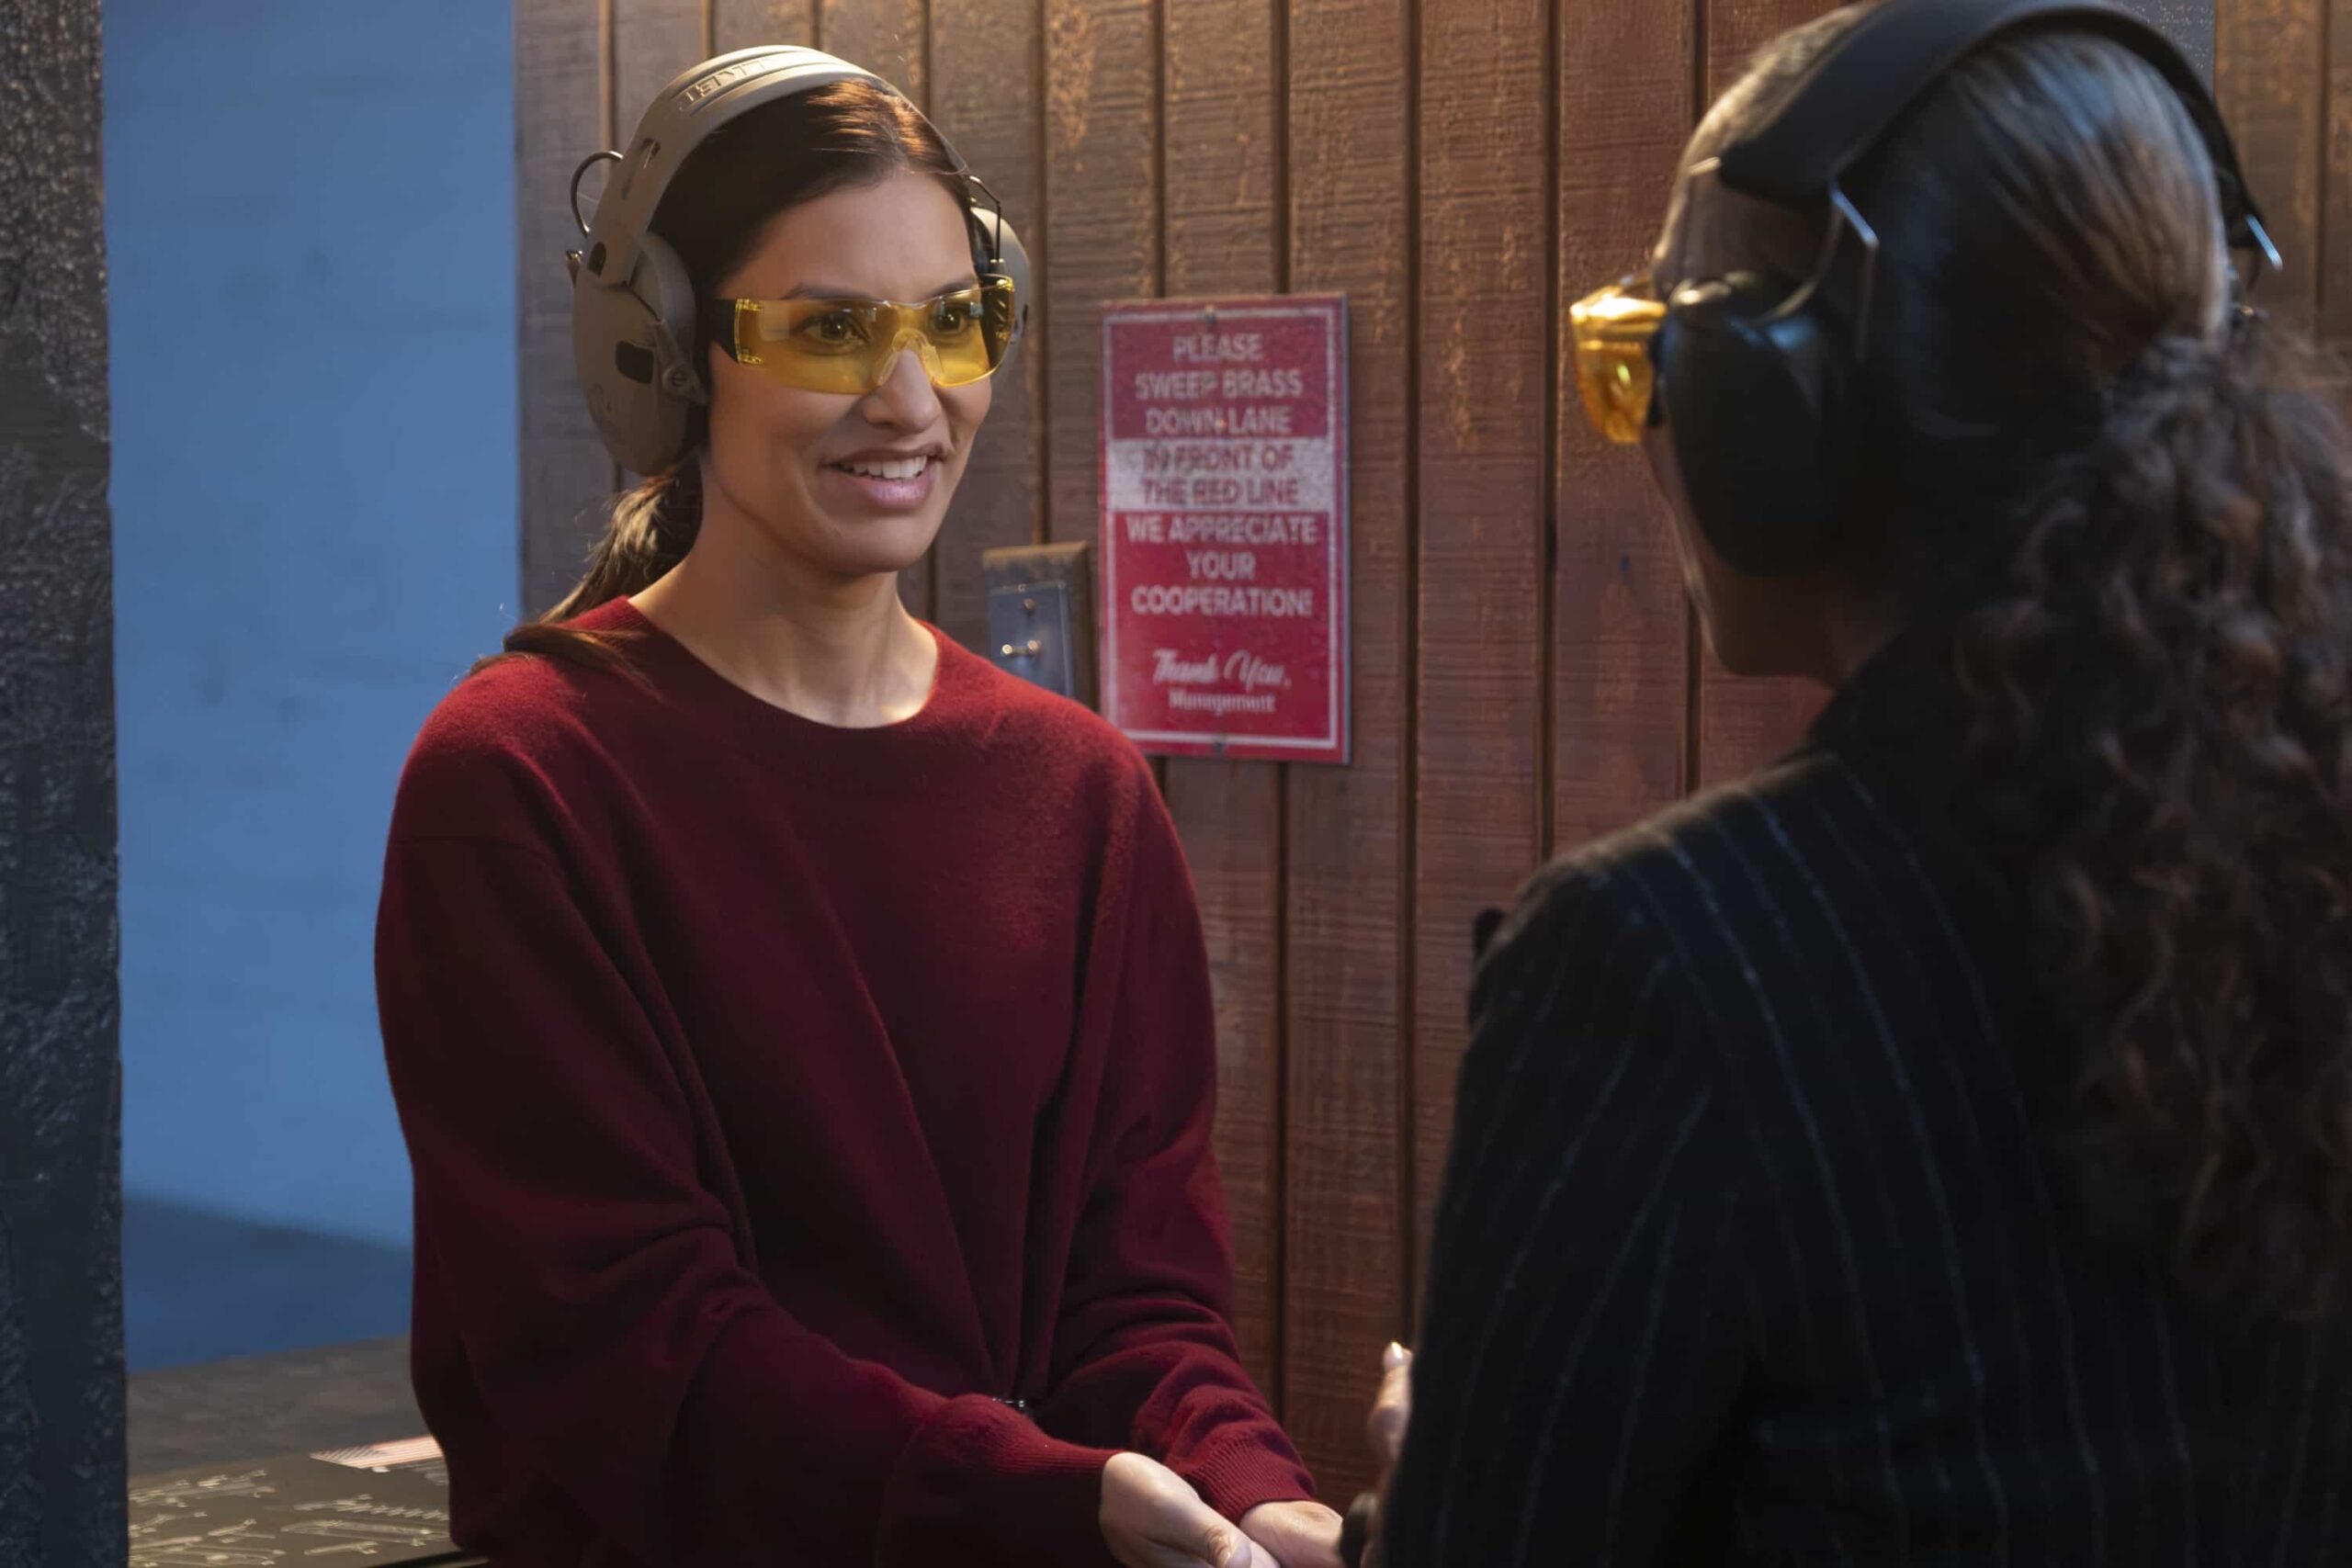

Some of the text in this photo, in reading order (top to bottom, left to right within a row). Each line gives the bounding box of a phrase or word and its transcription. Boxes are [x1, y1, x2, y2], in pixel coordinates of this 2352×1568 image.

[1172, 333, 1263, 363] PLEASE
[1135, 369, 1304, 400] SWEEP BRASS
[1227, 405, 1294, 434] LANE
[1173, 446, 1253, 472] FRONT
[1261, 445, 1295, 471] OF
[1141, 478, 1187, 504] THE
[1247, 478, 1299, 504] LINE
[1125, 514, 1317, 545] WE APPRECIATE
[1186, 549, 1258, 581] YOUR
[1151, 649, 1218, 684] Thank
[1168, 689, 1277, 716] Management
